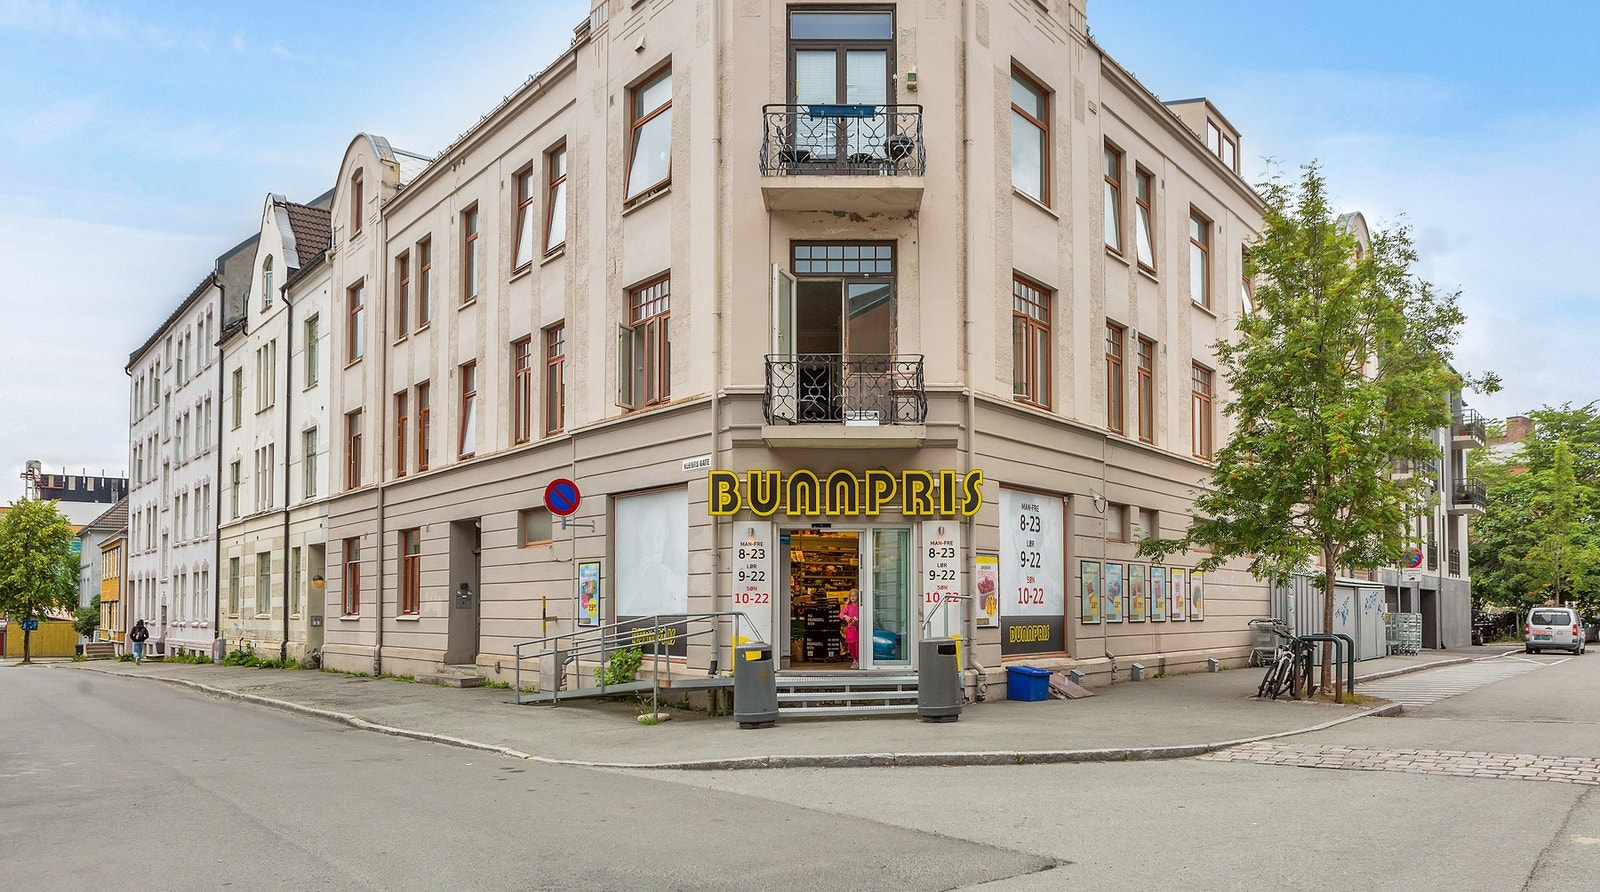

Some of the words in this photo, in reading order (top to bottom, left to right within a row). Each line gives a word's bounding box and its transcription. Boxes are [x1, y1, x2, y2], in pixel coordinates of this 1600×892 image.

[700, 458, 710, 467] GATE
[708, 468, 983, 517] BUNNPRIS
[1022, 502, 1040, 512] MAN-FRE
[1020, 514, 1040, 533] 8-23
[1026, 540, 1035, 548] LØR
[738, 548, 766, 560] 8-23
[928, 548, 955, 558] 8-23
[1020, 551, 1041, 568] 9-22
[738, 571, 765, 582] 9-22
[928, 570, 956, 580] 9-22
[734, 592, 769, 604] 10-22
[926, 592, 959, 602] 1022
[1018, 588, 1044, 604] 10-22
[1010, 624, 1050, 643] BUNNPRIS
